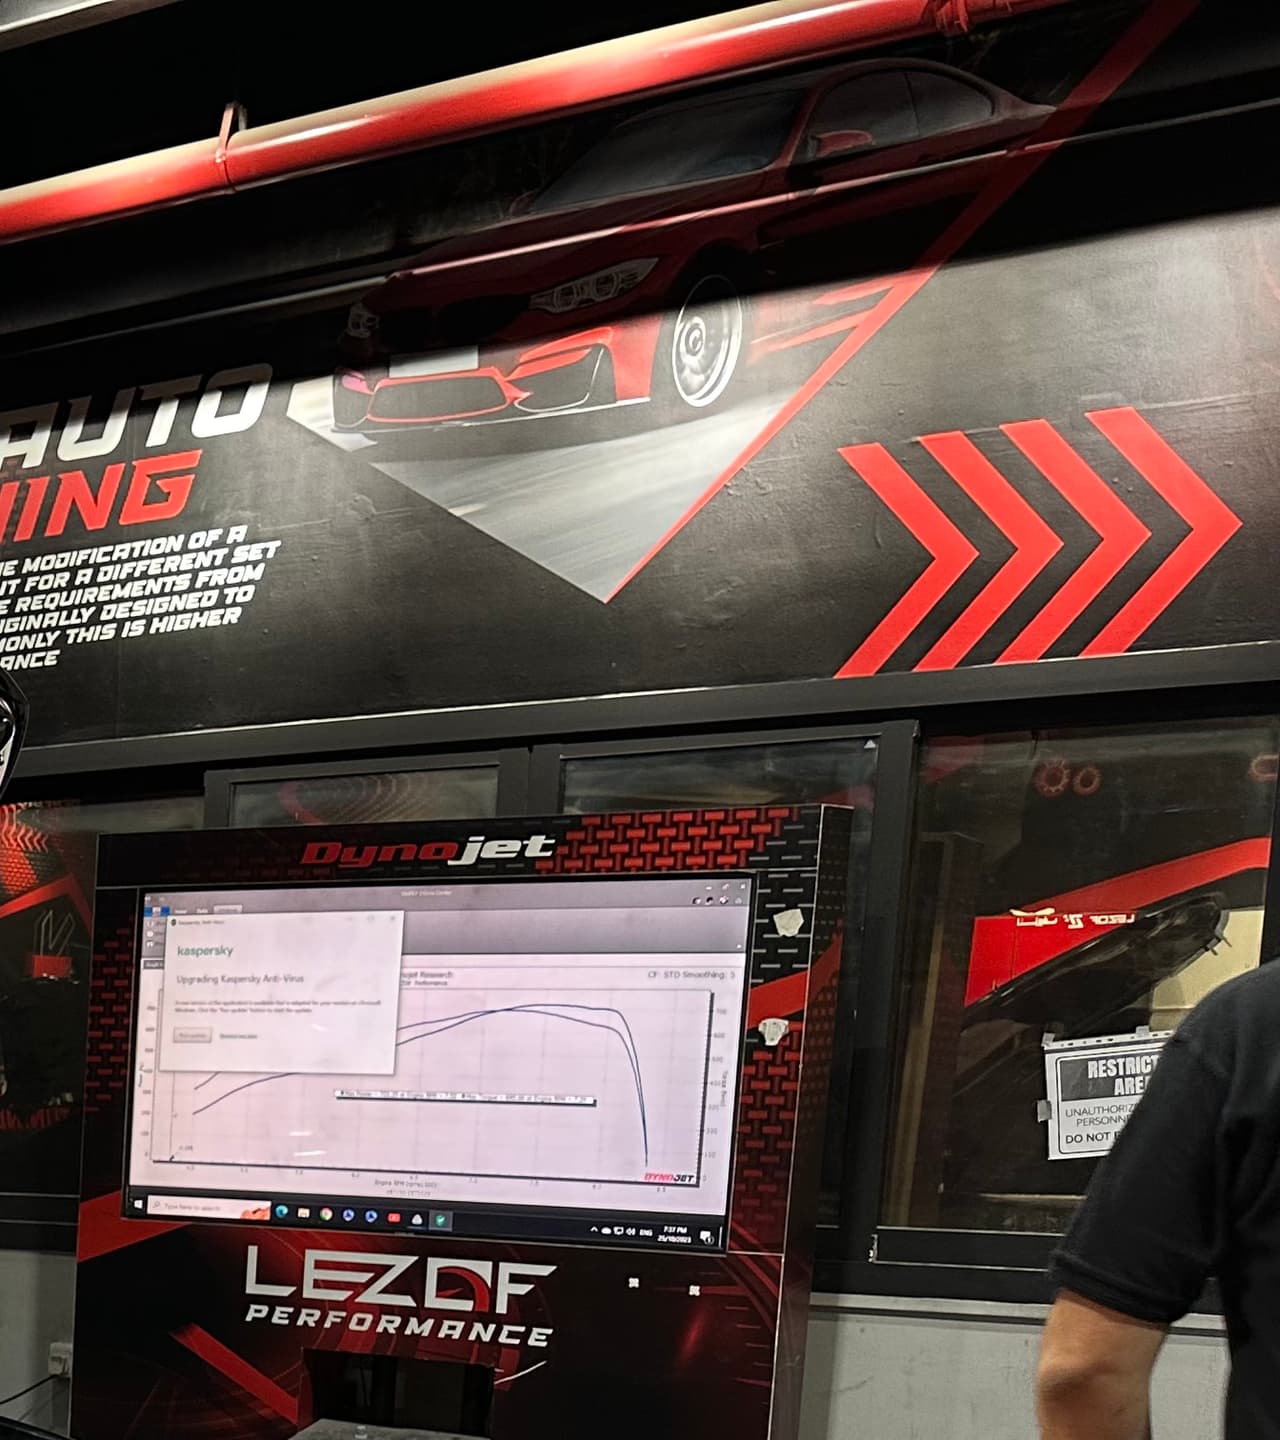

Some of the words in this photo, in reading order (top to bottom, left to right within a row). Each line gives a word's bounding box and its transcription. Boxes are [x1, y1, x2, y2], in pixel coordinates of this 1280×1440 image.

[21, 534, 184, 573] MODIFICATION
[188, 528, 223, 549] OF
[227, 525, 248, 544] A
[24, 572, 71, 593] FOR
[74, 568, 94, 586] A
[97, 548, 229, 582] DIFFERENT
[231, 540, 282, 564] SET
[15, 573, 191, 613] REQUIREMENTS
[195, 563, 265, 588] FROM
[100, 589, 219, 621] DESIGNED
[223, 585, 255, 605] TO
[66, 621, 117, 644] THIS
[121, 619, 145, 638] IS
[149, 606, 242, 634] HIGHER
[300, 835, 555, 868] Dynojet
[177, 945, 234, 958] kaspersky
[176, 974, 219, 986] Upgrading
[220, 973, 261, 985] Kaspersky
[262, 973, 305, 984] Anti-Virus
[1065, 1135, 1083, 1144] DO
[1086, 1131, 1111, 1142] NOT
[245, 1245, 557, 1314] LEZOF
[244, 1303, 554, 1348] PERFORMANCE
